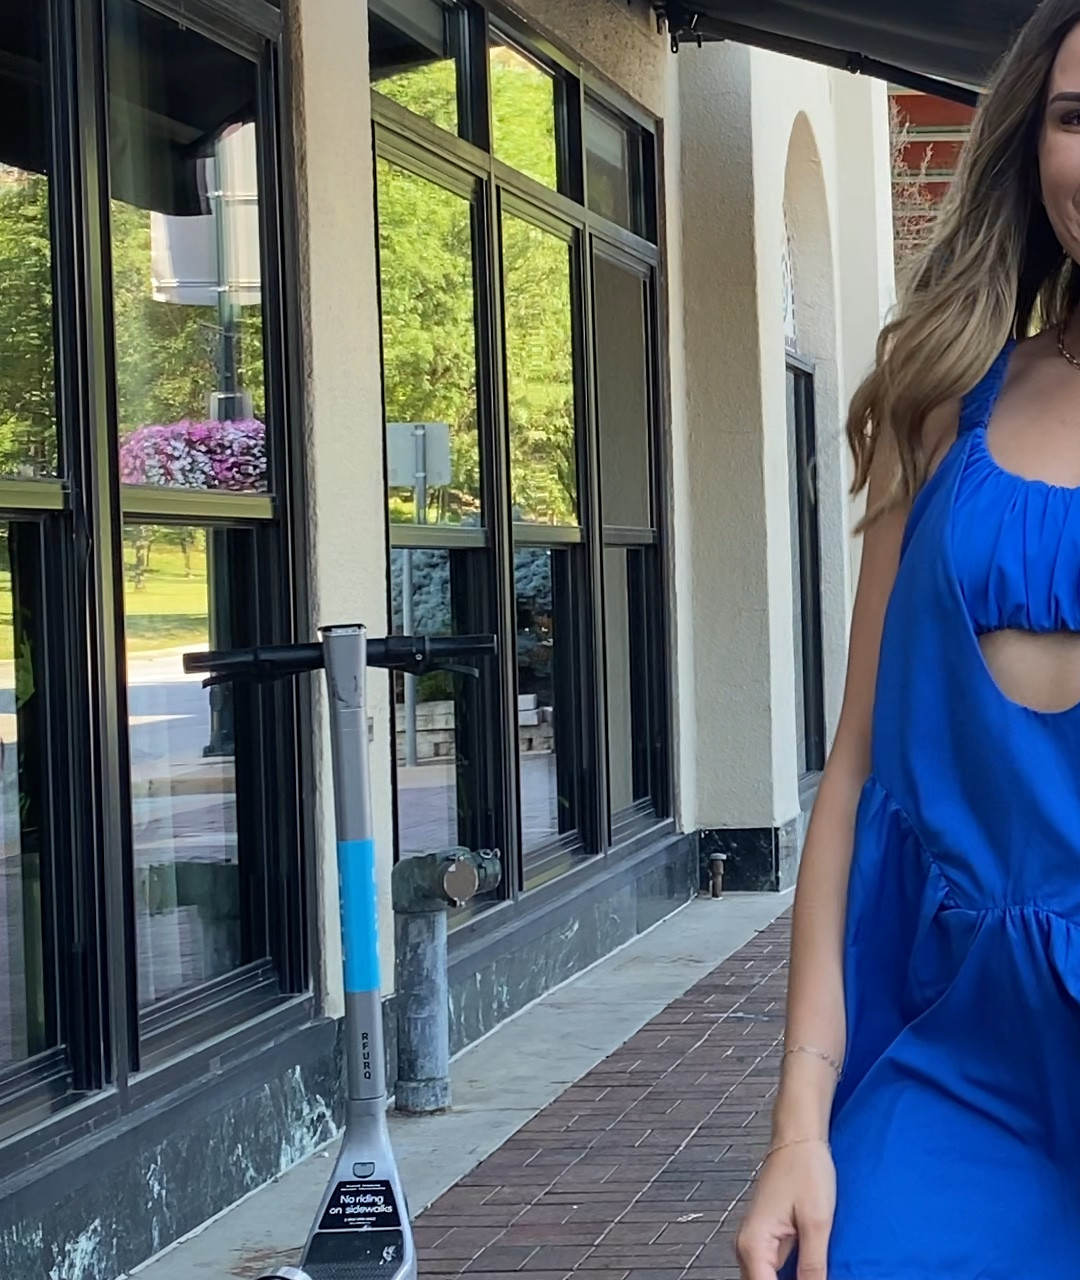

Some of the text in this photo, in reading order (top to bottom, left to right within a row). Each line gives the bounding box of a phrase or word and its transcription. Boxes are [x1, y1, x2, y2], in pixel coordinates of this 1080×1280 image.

[340, 1193, 384, 1205] No riding
[329, 1204, 393, 1215] on sidewalks
